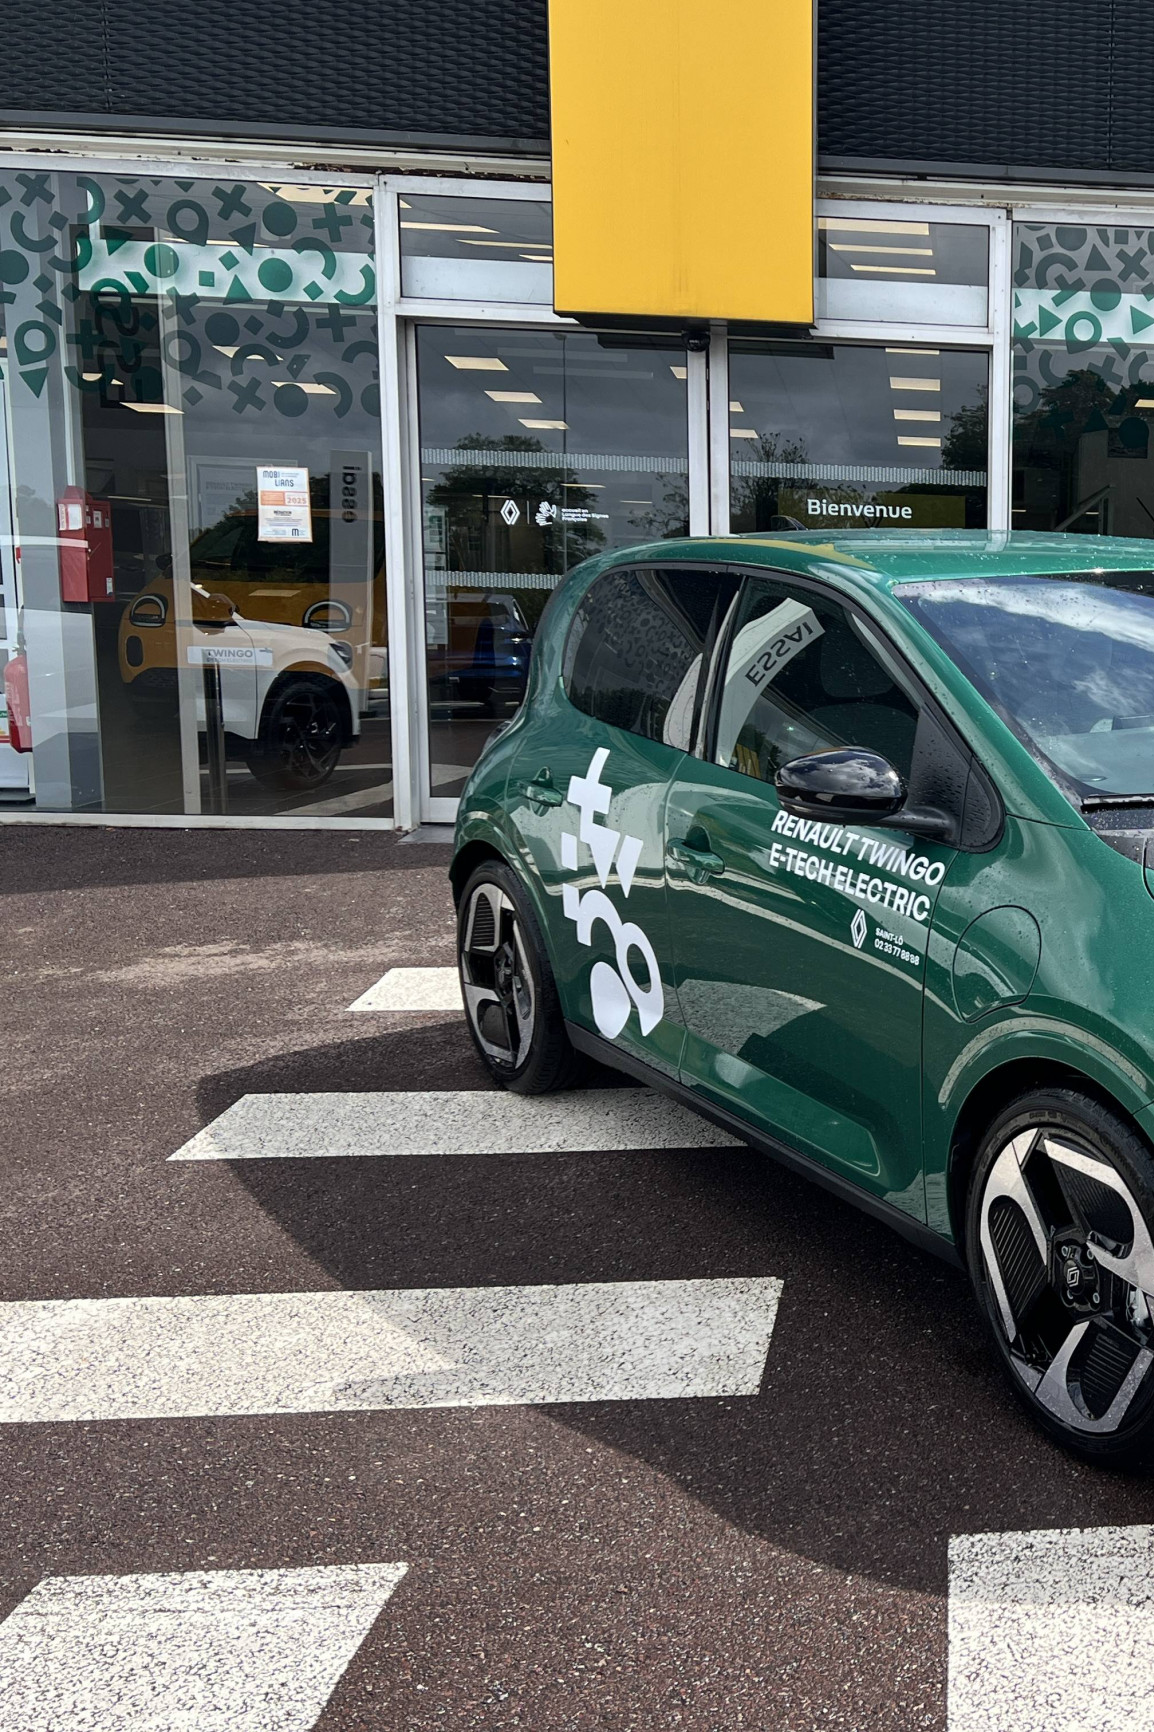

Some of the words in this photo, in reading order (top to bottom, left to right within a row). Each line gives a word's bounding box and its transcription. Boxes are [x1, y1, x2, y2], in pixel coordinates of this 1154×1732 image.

[287, 497, 307, 505] 2025
[807, 499, 912, 519] Bienvenue
[205, 648, 253, 658] TWINGO
[771, 809, 860, 856] RENAULT
[857, 837, 946, 886] TWINGO
[769, 842, 834, 885] E-TECH
[833, 864, 931, 921] ELECTRIC
[874, 938, 884, 950] 02
[892, 945, 902, 957] 77
